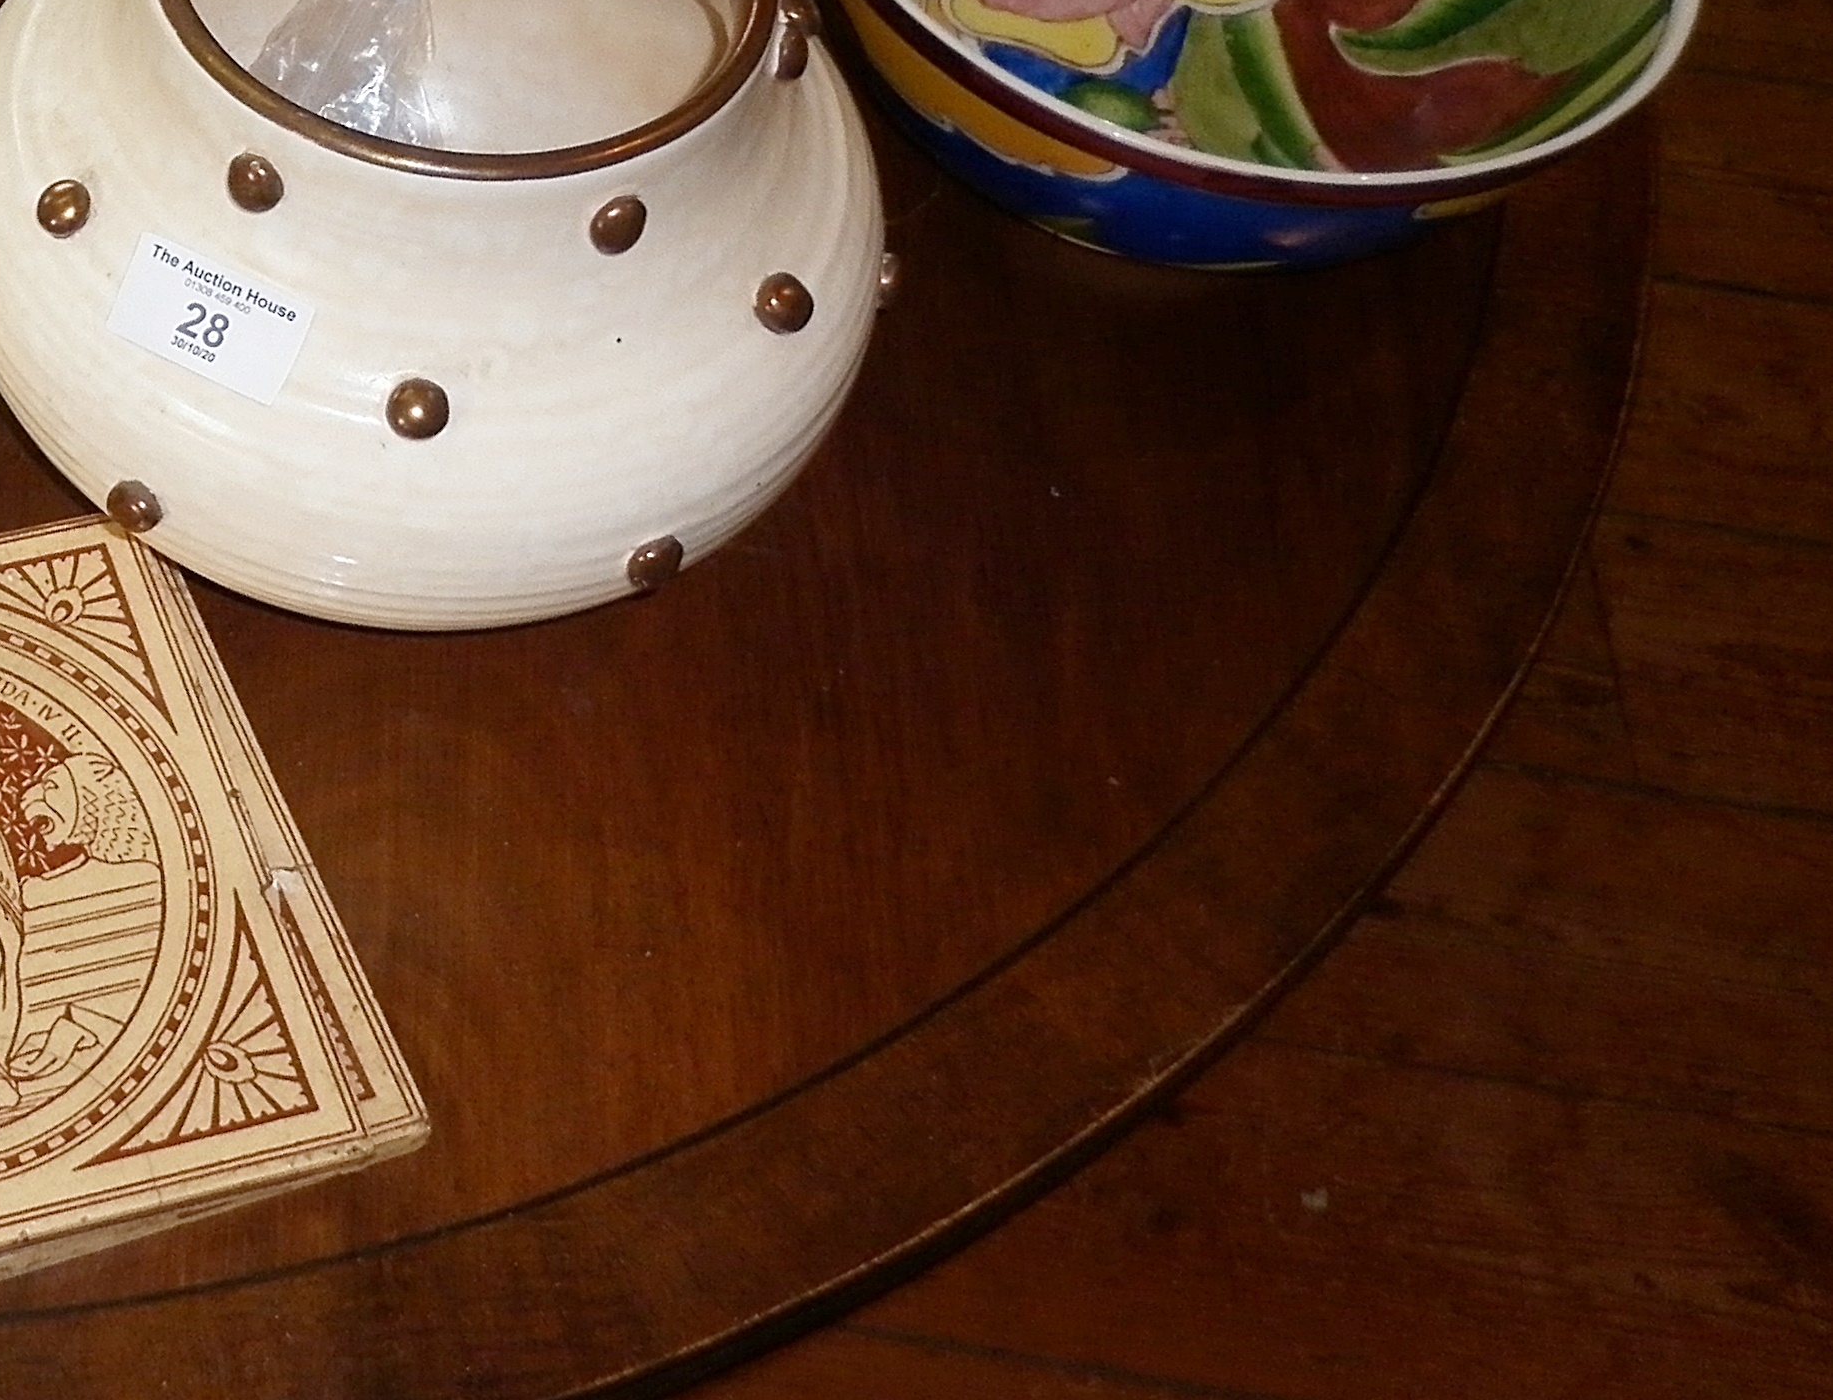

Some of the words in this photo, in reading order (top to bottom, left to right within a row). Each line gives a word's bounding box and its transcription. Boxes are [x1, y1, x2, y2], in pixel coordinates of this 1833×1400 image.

[152, 243, 180, 268] The
[181, 259, 243, 298] Auction
[245, 288, 298, 322] House
[175, 302, 230, 348] 28
[170, 335, 217, 364] 30/10/20
